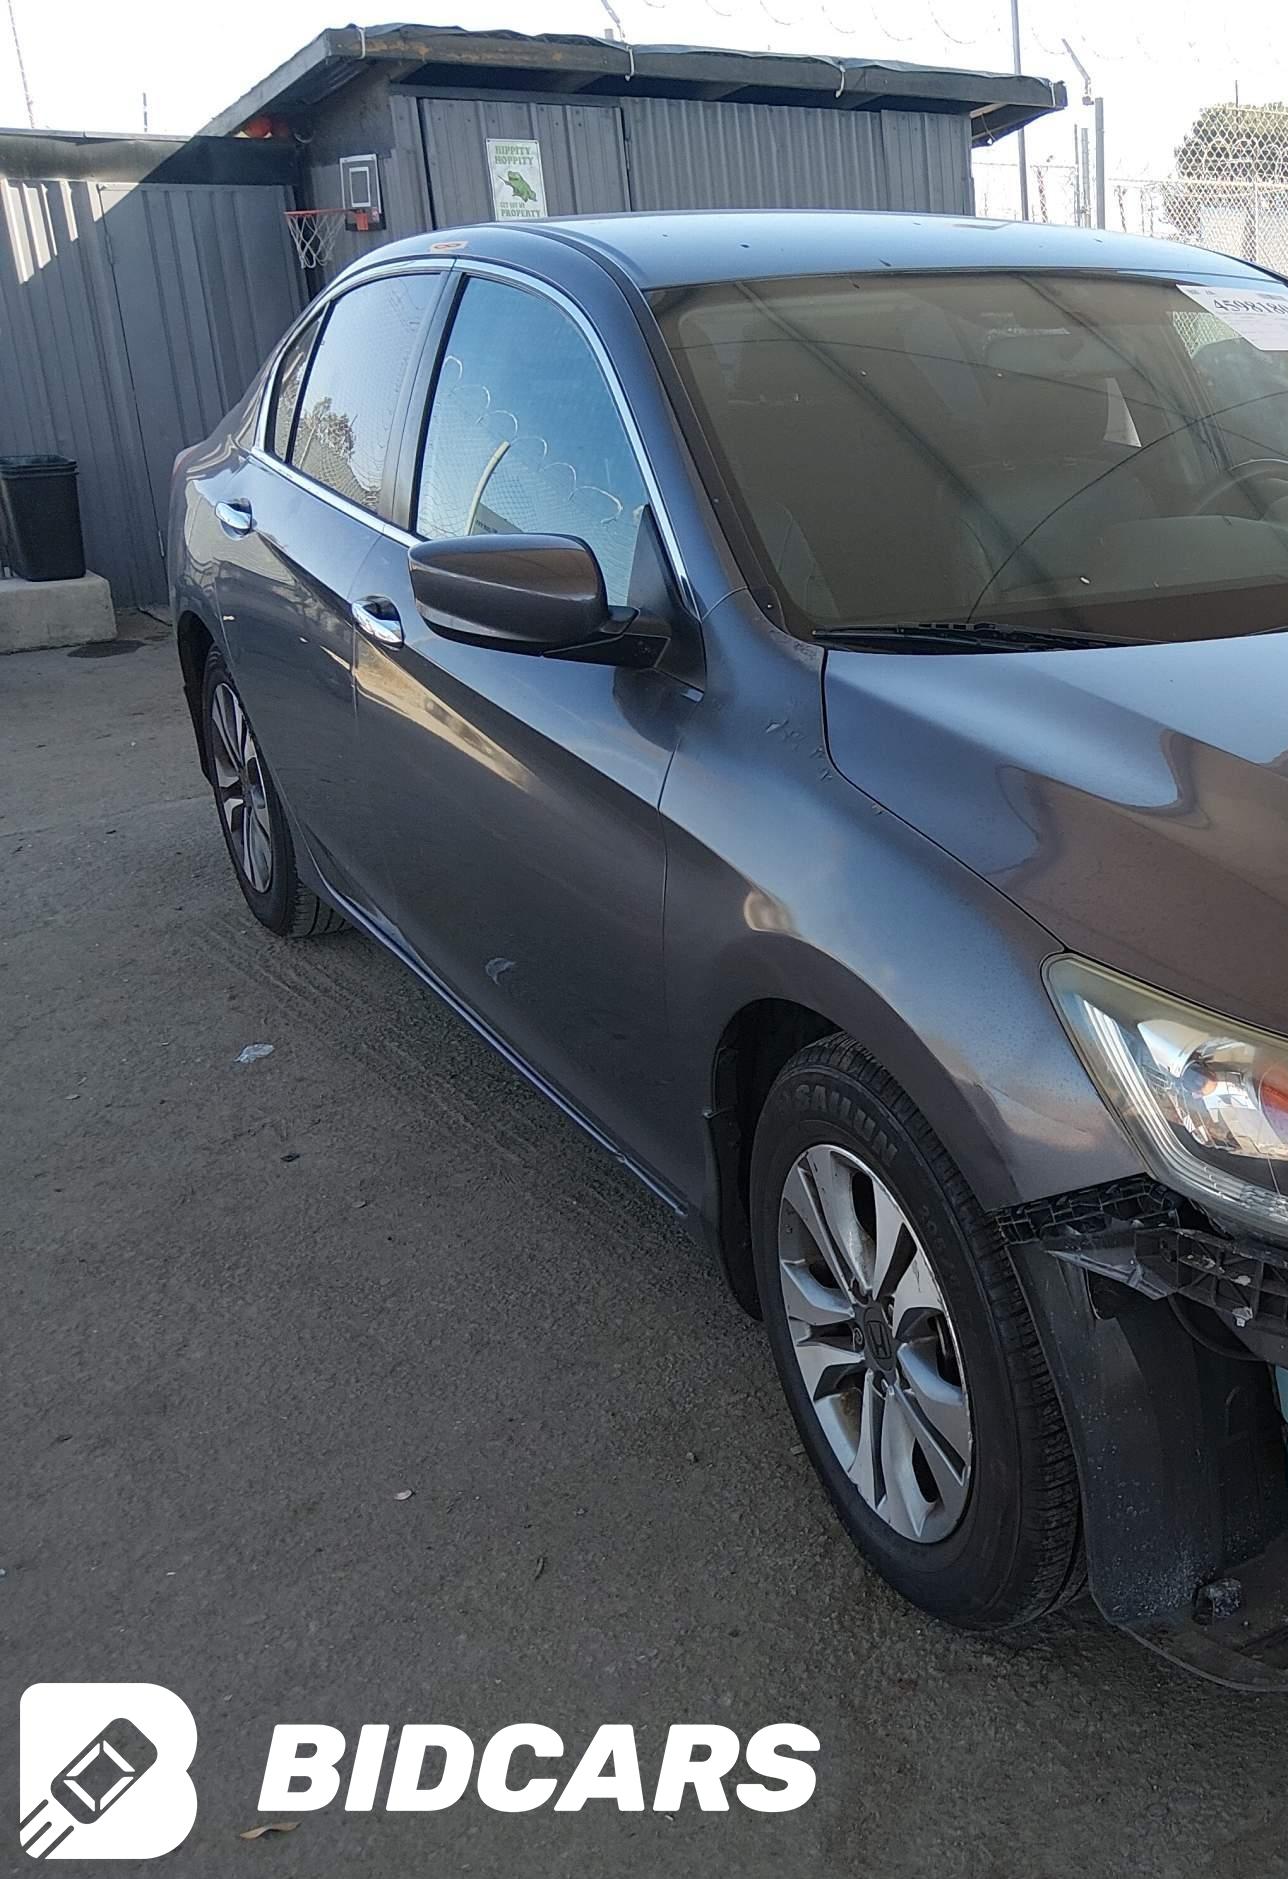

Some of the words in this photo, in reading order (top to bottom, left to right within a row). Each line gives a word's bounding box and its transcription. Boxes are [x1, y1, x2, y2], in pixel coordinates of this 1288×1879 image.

[495, 145, 532, 155] HIPPITY
[494, 155, 534, 165] HOPPITY
[501, 209, 541, 218] PROPERTY
